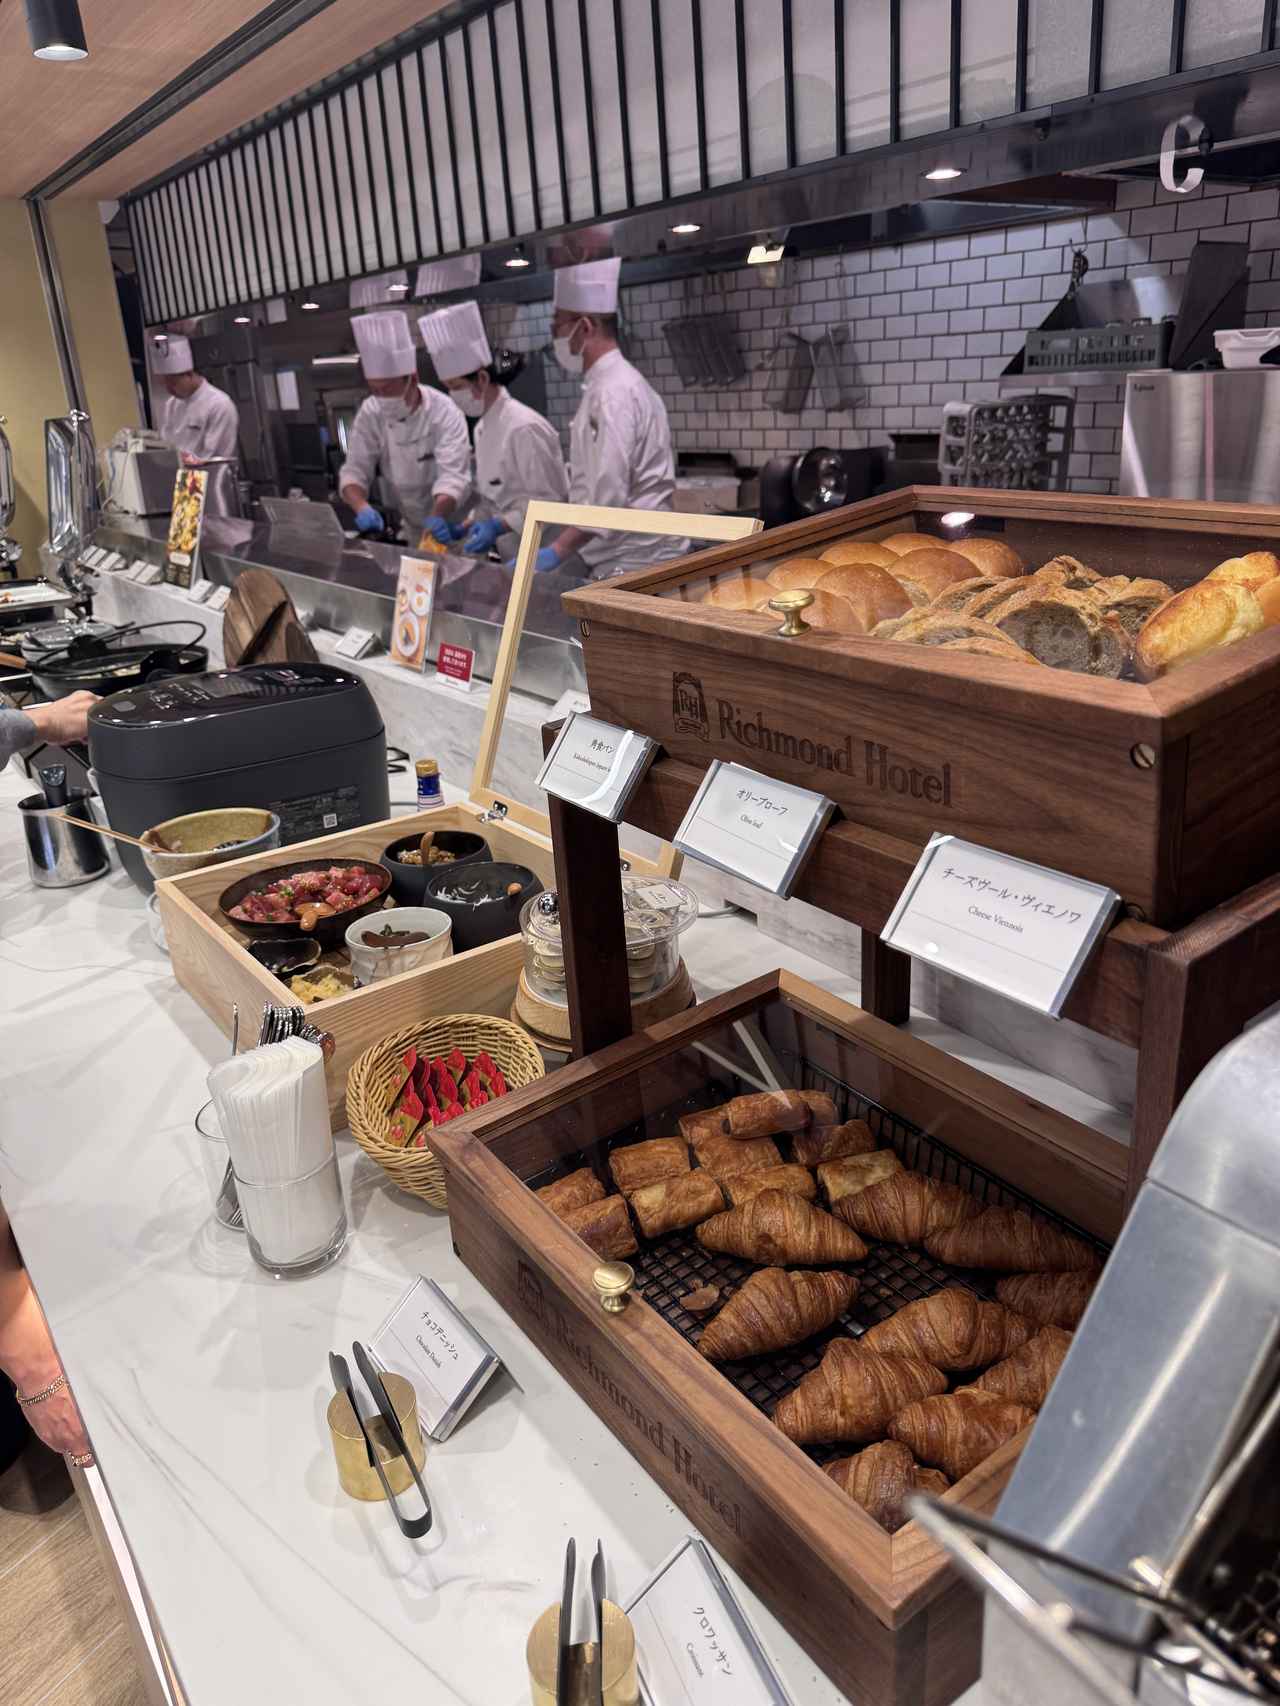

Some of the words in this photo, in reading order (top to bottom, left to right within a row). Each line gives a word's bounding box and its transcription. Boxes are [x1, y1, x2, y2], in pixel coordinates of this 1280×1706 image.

[716, 698, 856, 778] Richmond
[863, 739, 953, 809] Hotel
[671, 1434, 743, 1535] Hotel
[692, 1606, 734, 1676] クロワッサン
